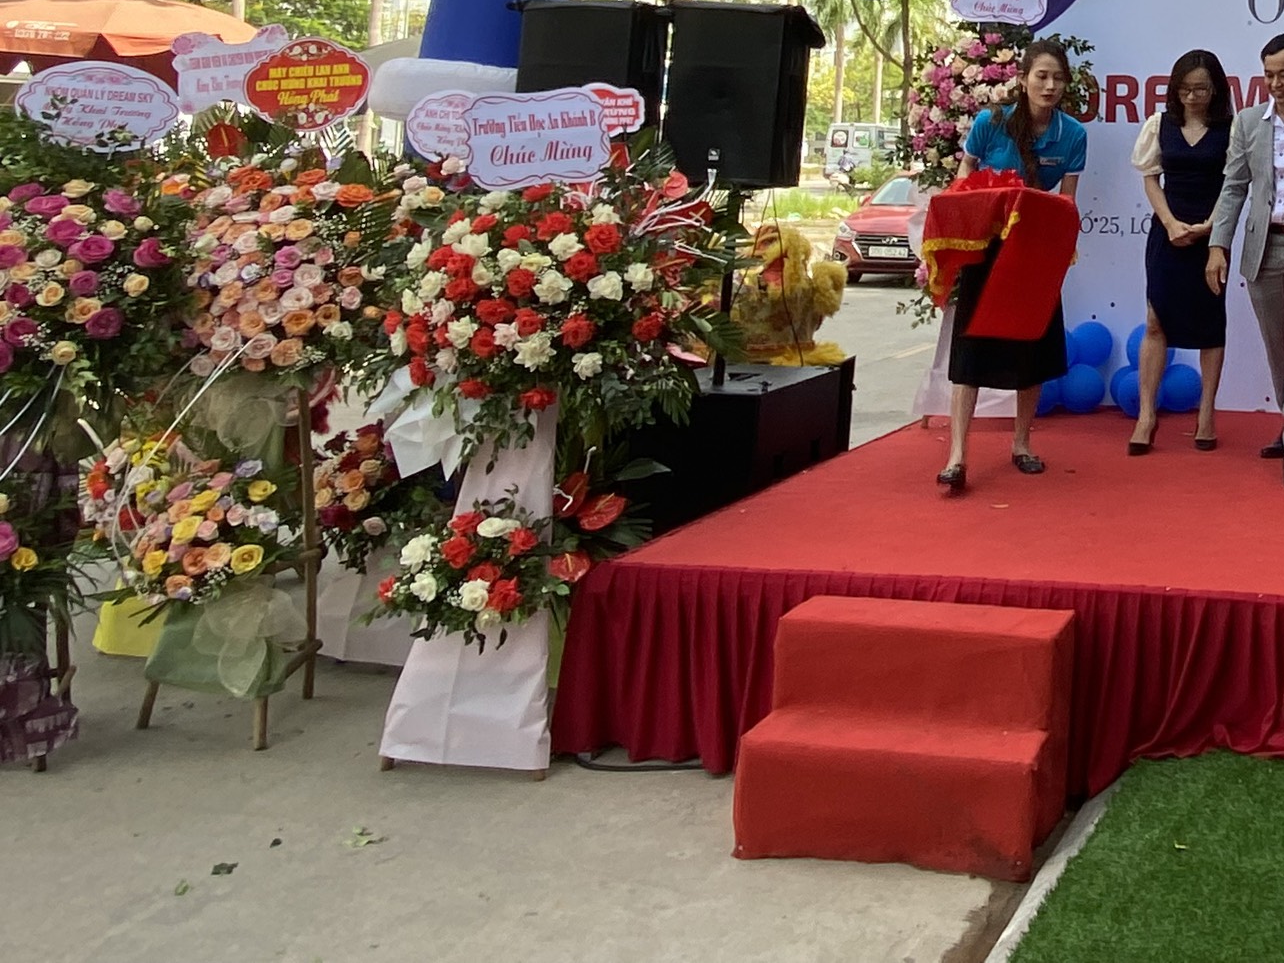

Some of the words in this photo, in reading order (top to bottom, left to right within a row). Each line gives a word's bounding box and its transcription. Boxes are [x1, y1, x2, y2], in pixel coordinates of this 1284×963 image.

[315, 65, 331, 76] LAN
[107, 90, 136, 102] DREAM
[137, 92, 154, 103] SKY
[277, 90, 309, 106] Hồng
[310, 88, 340, 104] Phát
[472, 117, 506, 138] Trường
[508, 113, 526, 133] Tiểu
[529, 114, 545, 138] Học
[548, 112, 559, 130] An
[560, 110, 588, 128] Khánh
[589, 110, 596, 127] B
[490, 141, 536, 167] Chúc
[540, 139, 593, 163] Mừng
